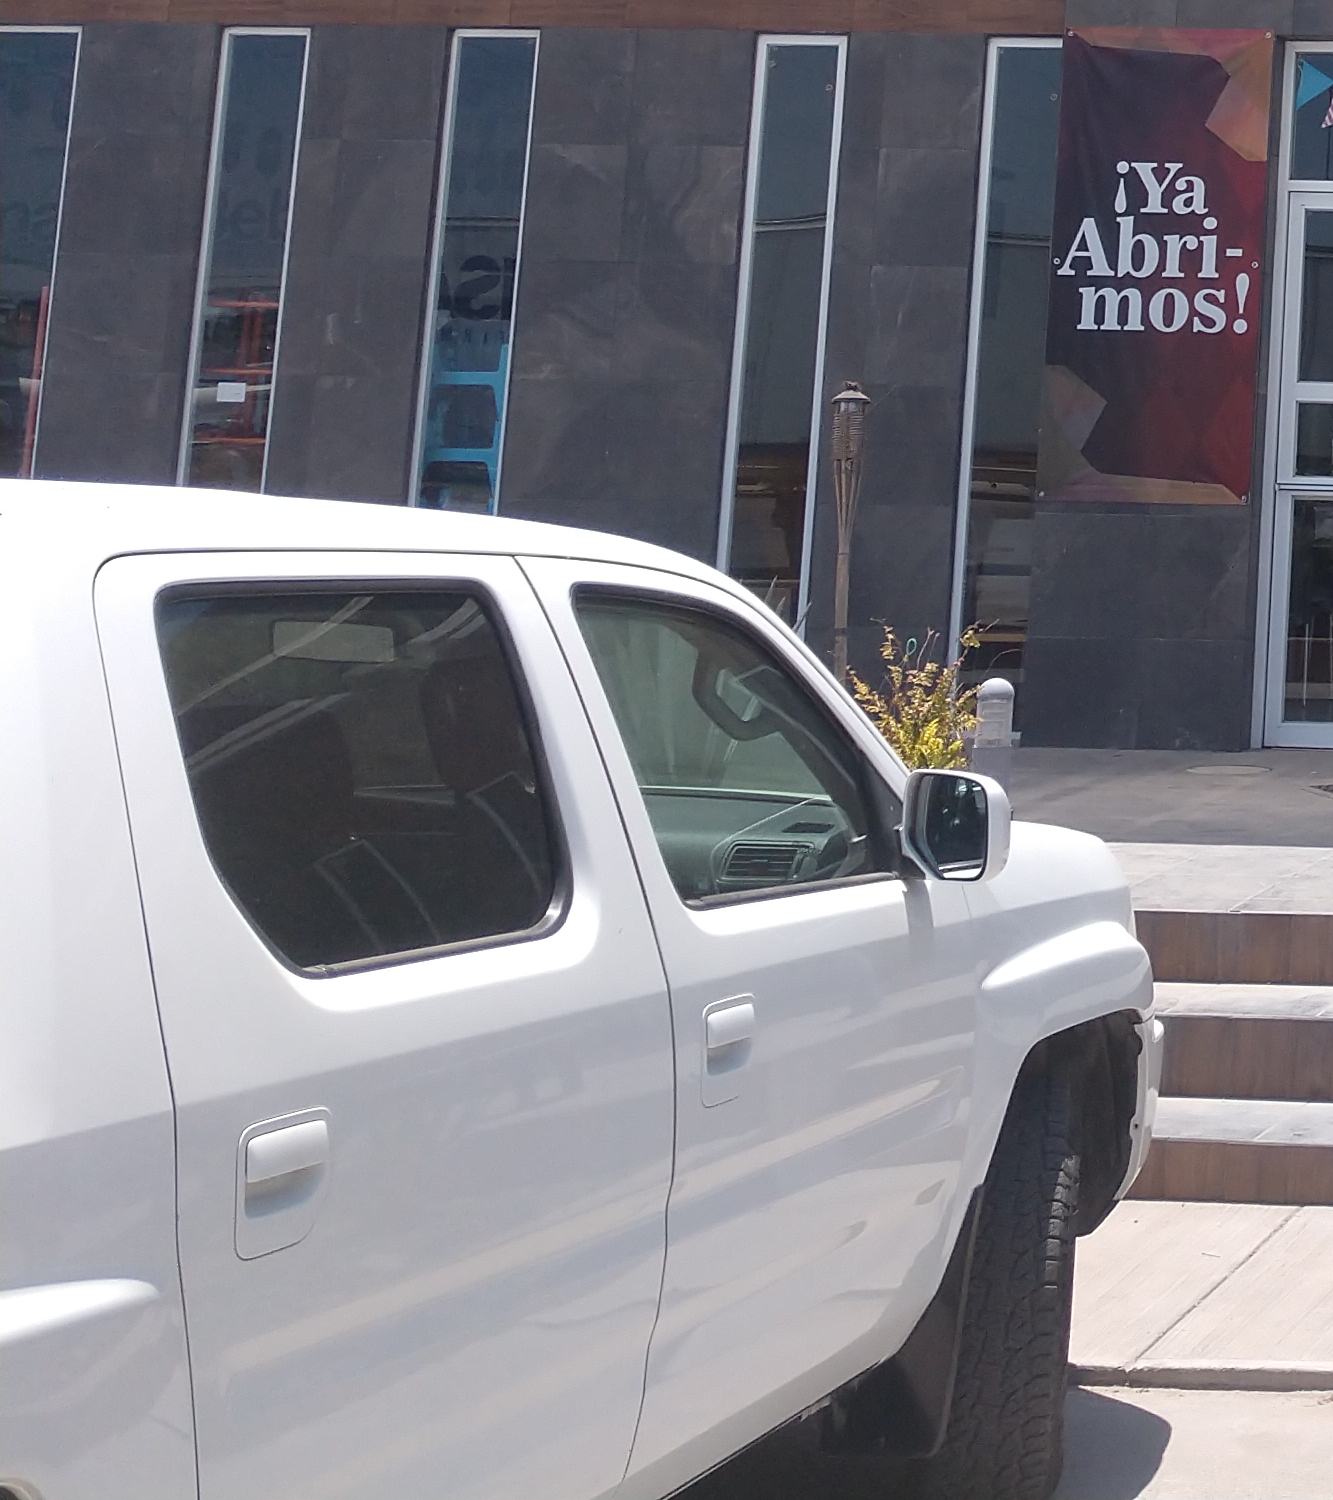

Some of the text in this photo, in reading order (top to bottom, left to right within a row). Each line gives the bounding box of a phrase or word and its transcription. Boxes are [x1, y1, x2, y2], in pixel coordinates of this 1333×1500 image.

[1114, 159, 1208, 217] ¡Ya
[1057, 216, 1243, 278] Abri-
[1076, 273, 1251, 335] mos!
